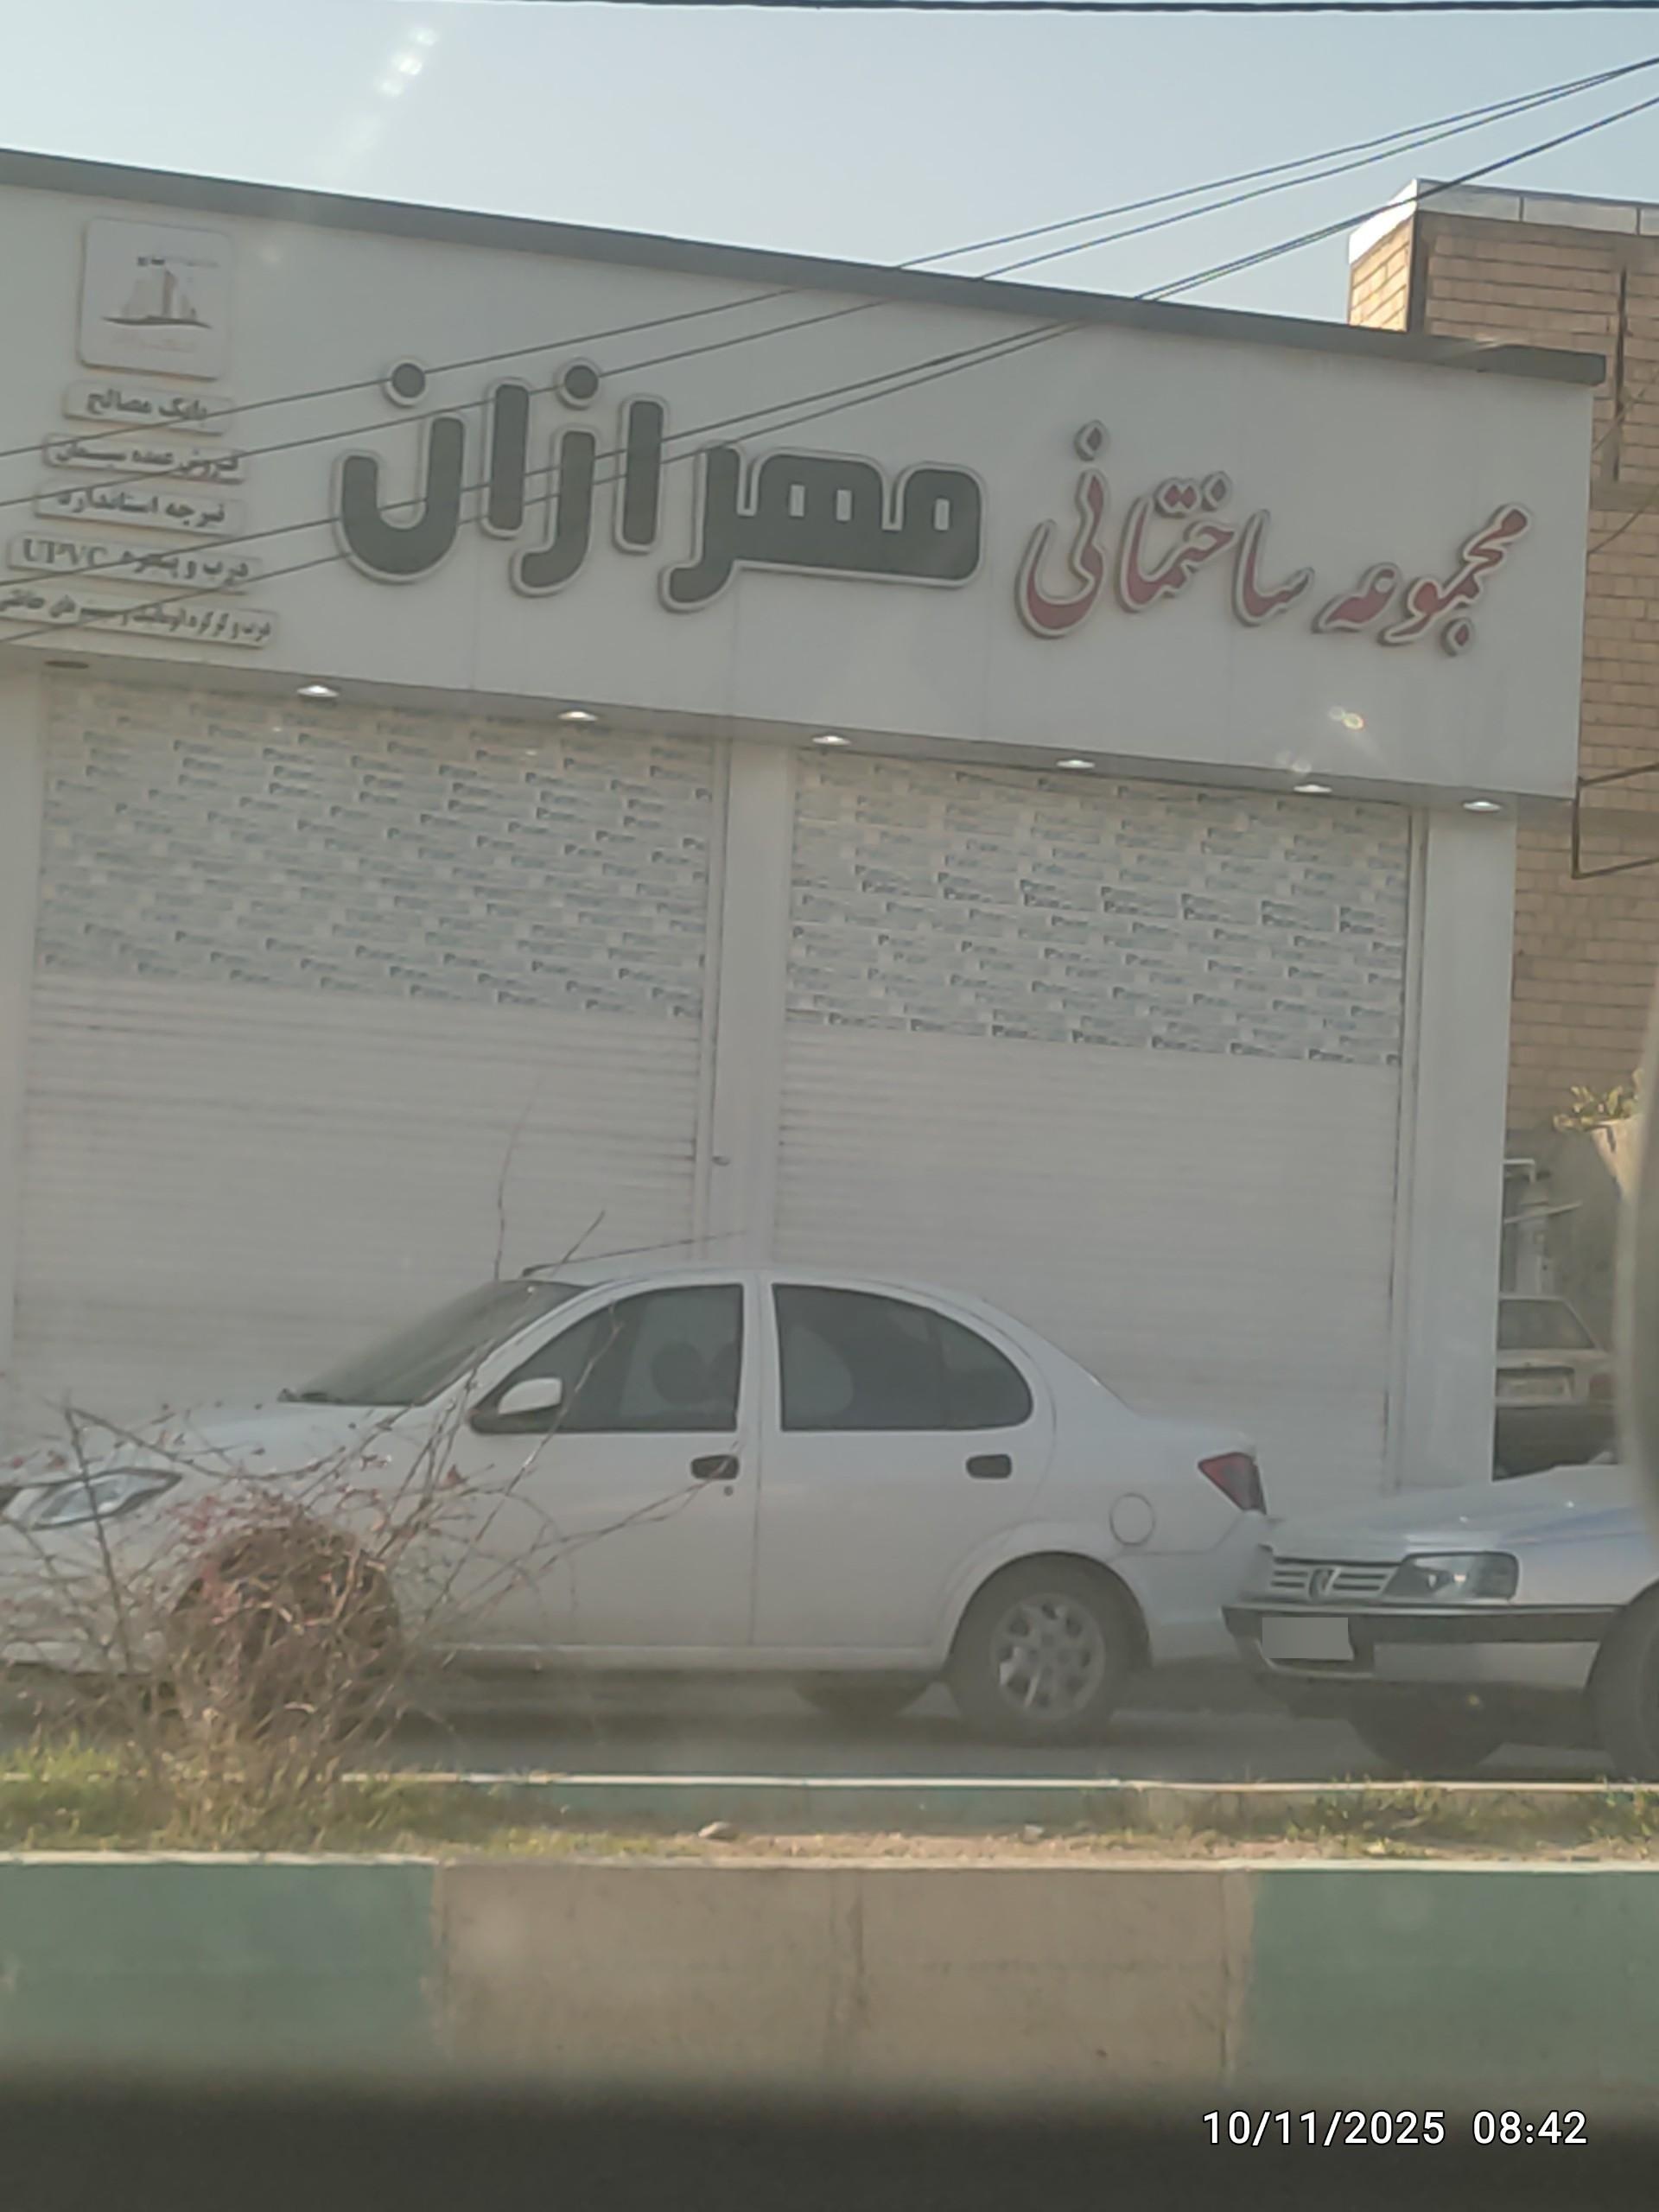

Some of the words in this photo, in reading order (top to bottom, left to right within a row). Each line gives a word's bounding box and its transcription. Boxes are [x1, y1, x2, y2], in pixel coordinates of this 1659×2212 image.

[86, 388, 150, 414] مصالح
[23, 537, 108, 567] UPVC
[335, 359, 983, 610] مهرازان
[1016, 421, 1314, 639] ساختمانی
[1313, 503, 1529, 656] مجموعه
